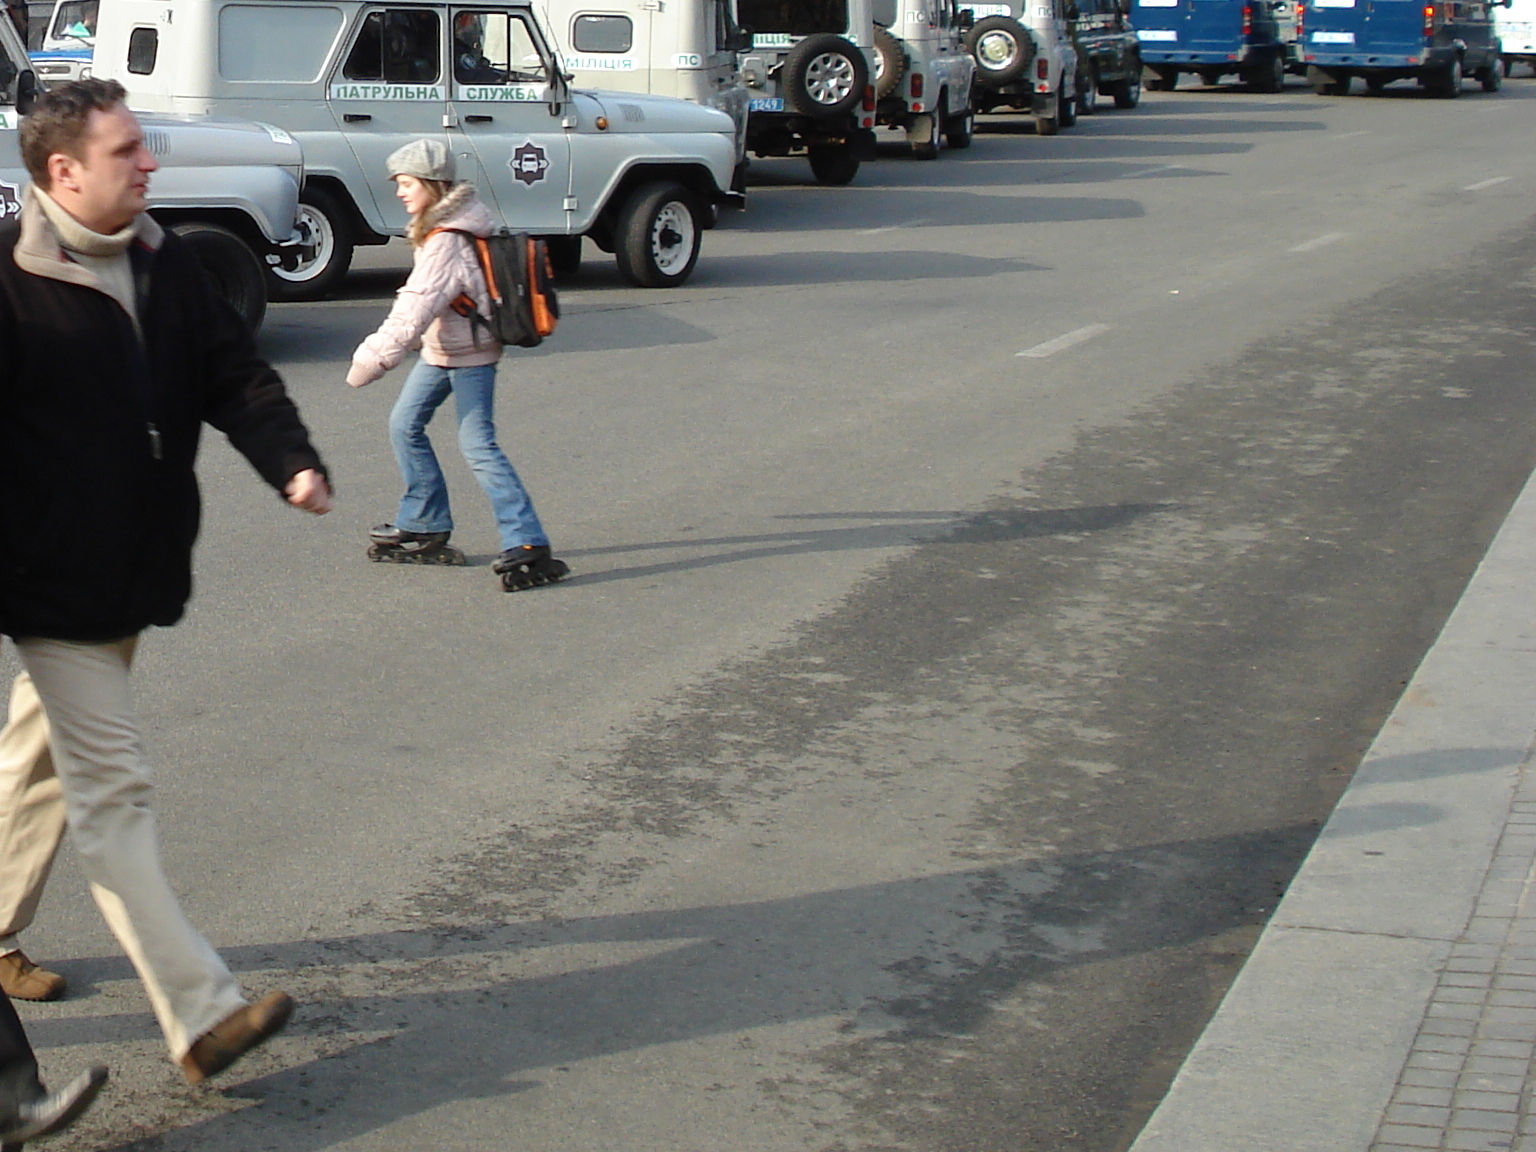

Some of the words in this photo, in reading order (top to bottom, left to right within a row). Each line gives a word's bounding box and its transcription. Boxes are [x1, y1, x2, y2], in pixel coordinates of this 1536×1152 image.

[907, 11, 925, 23] ПС
[565, 57, 632, 69] МІЛІЦІЯ
[678, 55, 698, 66] ПС
[337, 85, 440, 100] ПАТРУЛЬНА
[466, 87, 537, 101] СЛУЖБА
